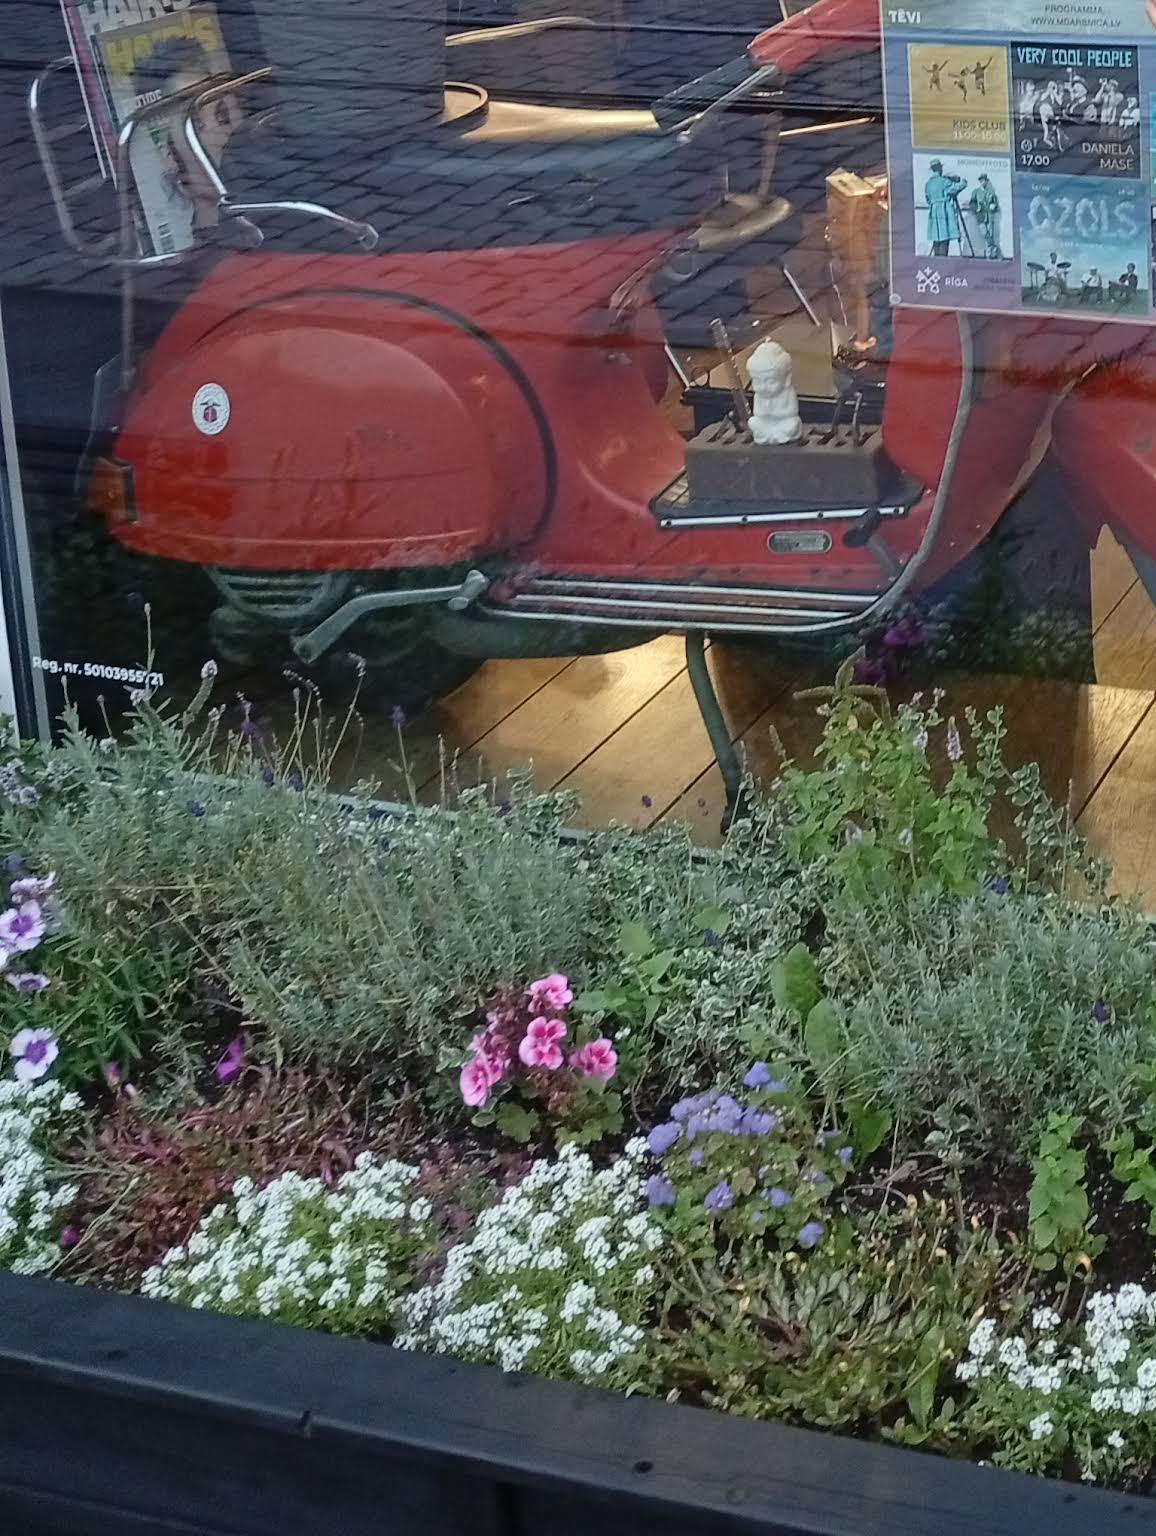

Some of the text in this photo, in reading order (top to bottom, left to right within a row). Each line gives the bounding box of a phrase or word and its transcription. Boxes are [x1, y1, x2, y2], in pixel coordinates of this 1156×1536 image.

[888, 7, 921, 24] TĒVI
[1017, 47, 1132, 68] VERY COOL PEOPLE
[1082, 142, 1135, 156] DANIELA
[1021, 154, 1050, 166] 17.00
[1100, 158, 1134, 171] MASE
[32, 655, 164, 687] Reg. nr. 5010395521
